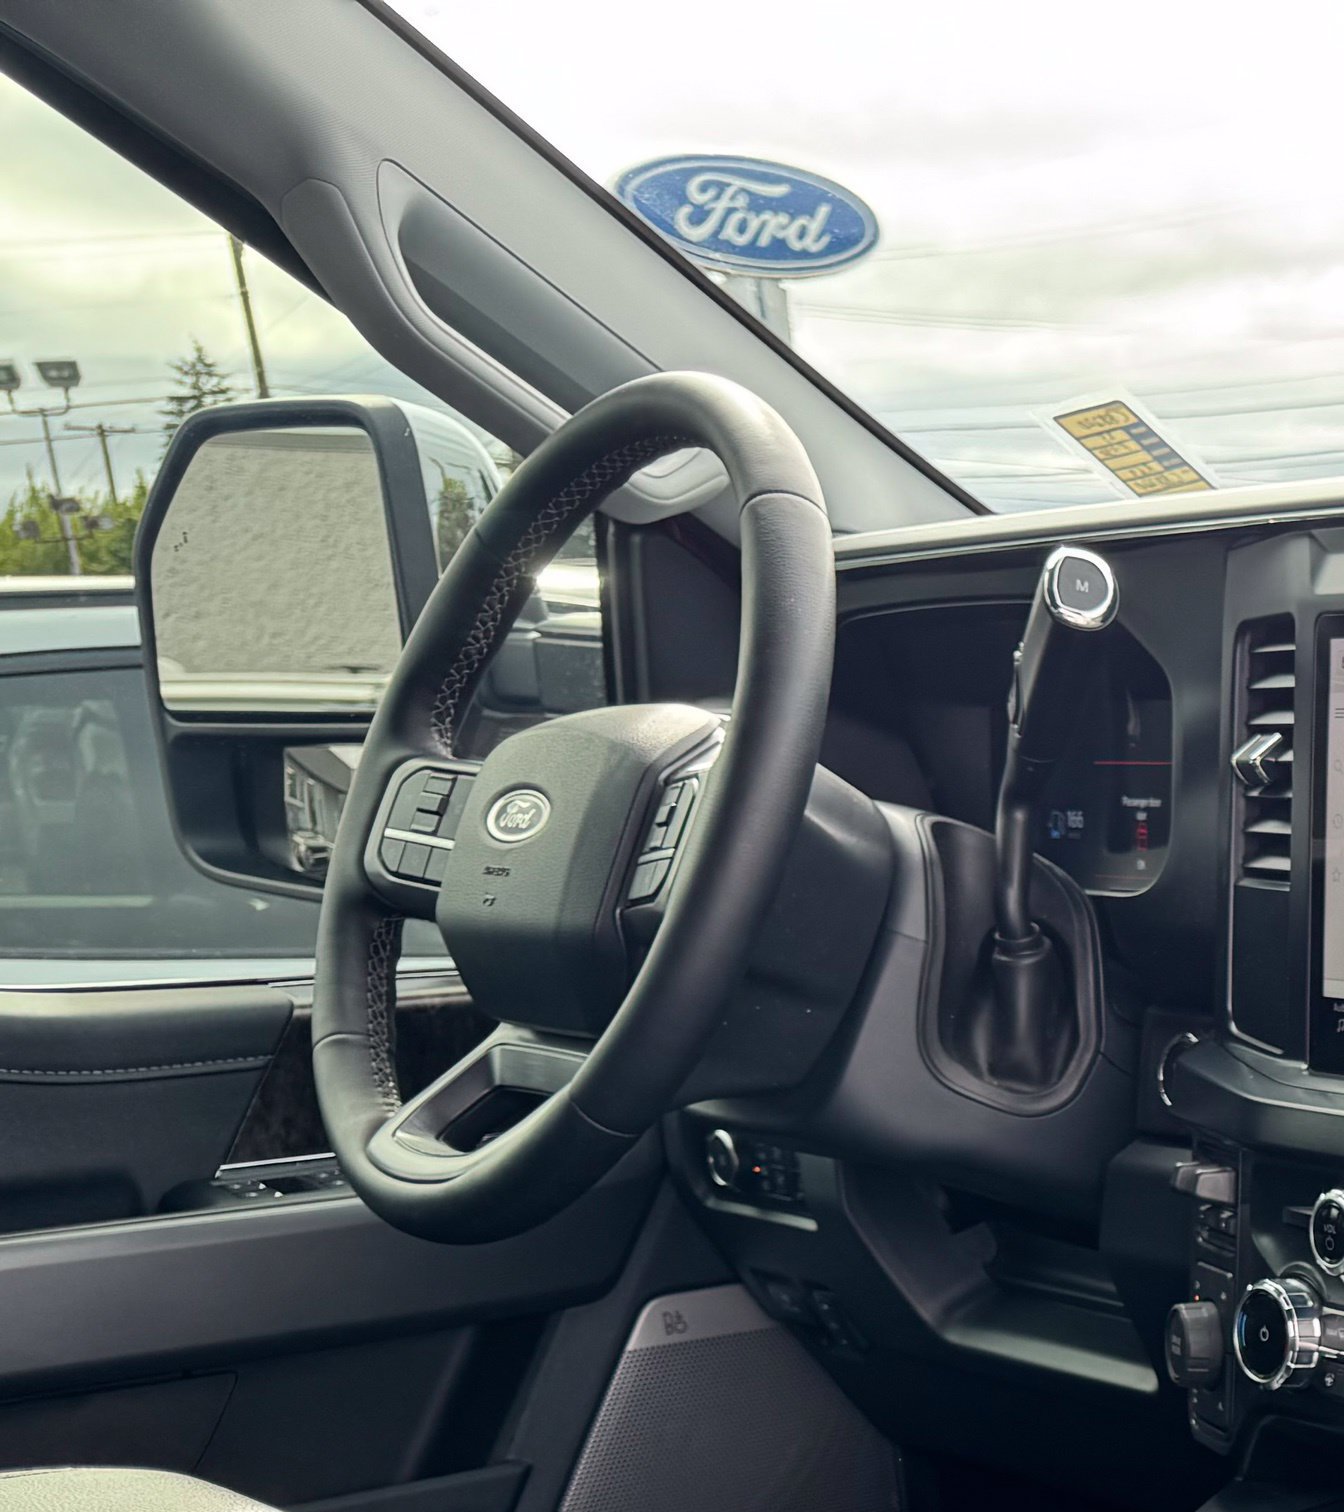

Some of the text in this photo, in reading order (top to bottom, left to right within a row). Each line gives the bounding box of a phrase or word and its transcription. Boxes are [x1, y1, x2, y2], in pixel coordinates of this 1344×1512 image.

[673, 171, 833, 254] Ford
[1075, 578, 1089, 593] M
[498, 799, 537, 829] Ford
[1323, 1223, 1337, 1235] VOL
